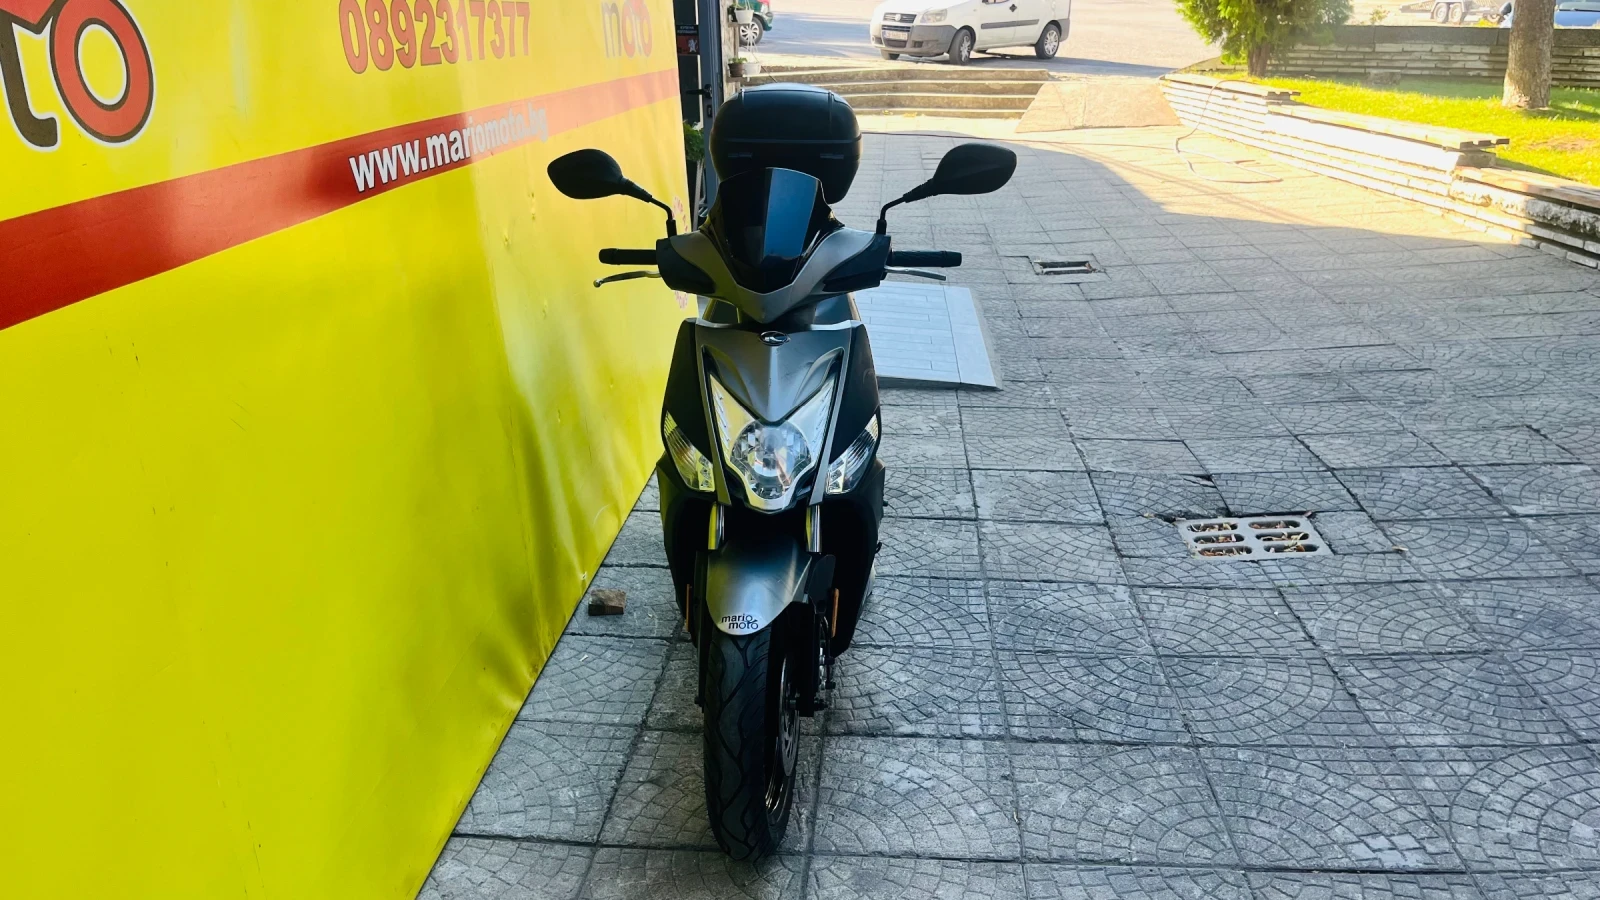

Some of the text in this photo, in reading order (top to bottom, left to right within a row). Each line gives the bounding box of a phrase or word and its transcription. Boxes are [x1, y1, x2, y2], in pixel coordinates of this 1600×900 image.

[339, 0, 531, 75] 0892317377
[602, 0, 653, 59] moto
[348, 101, 549, 194] www.mariomoto.bg
[721, 613, 753, 624] mario
[728, 618, 759, 630] moto
